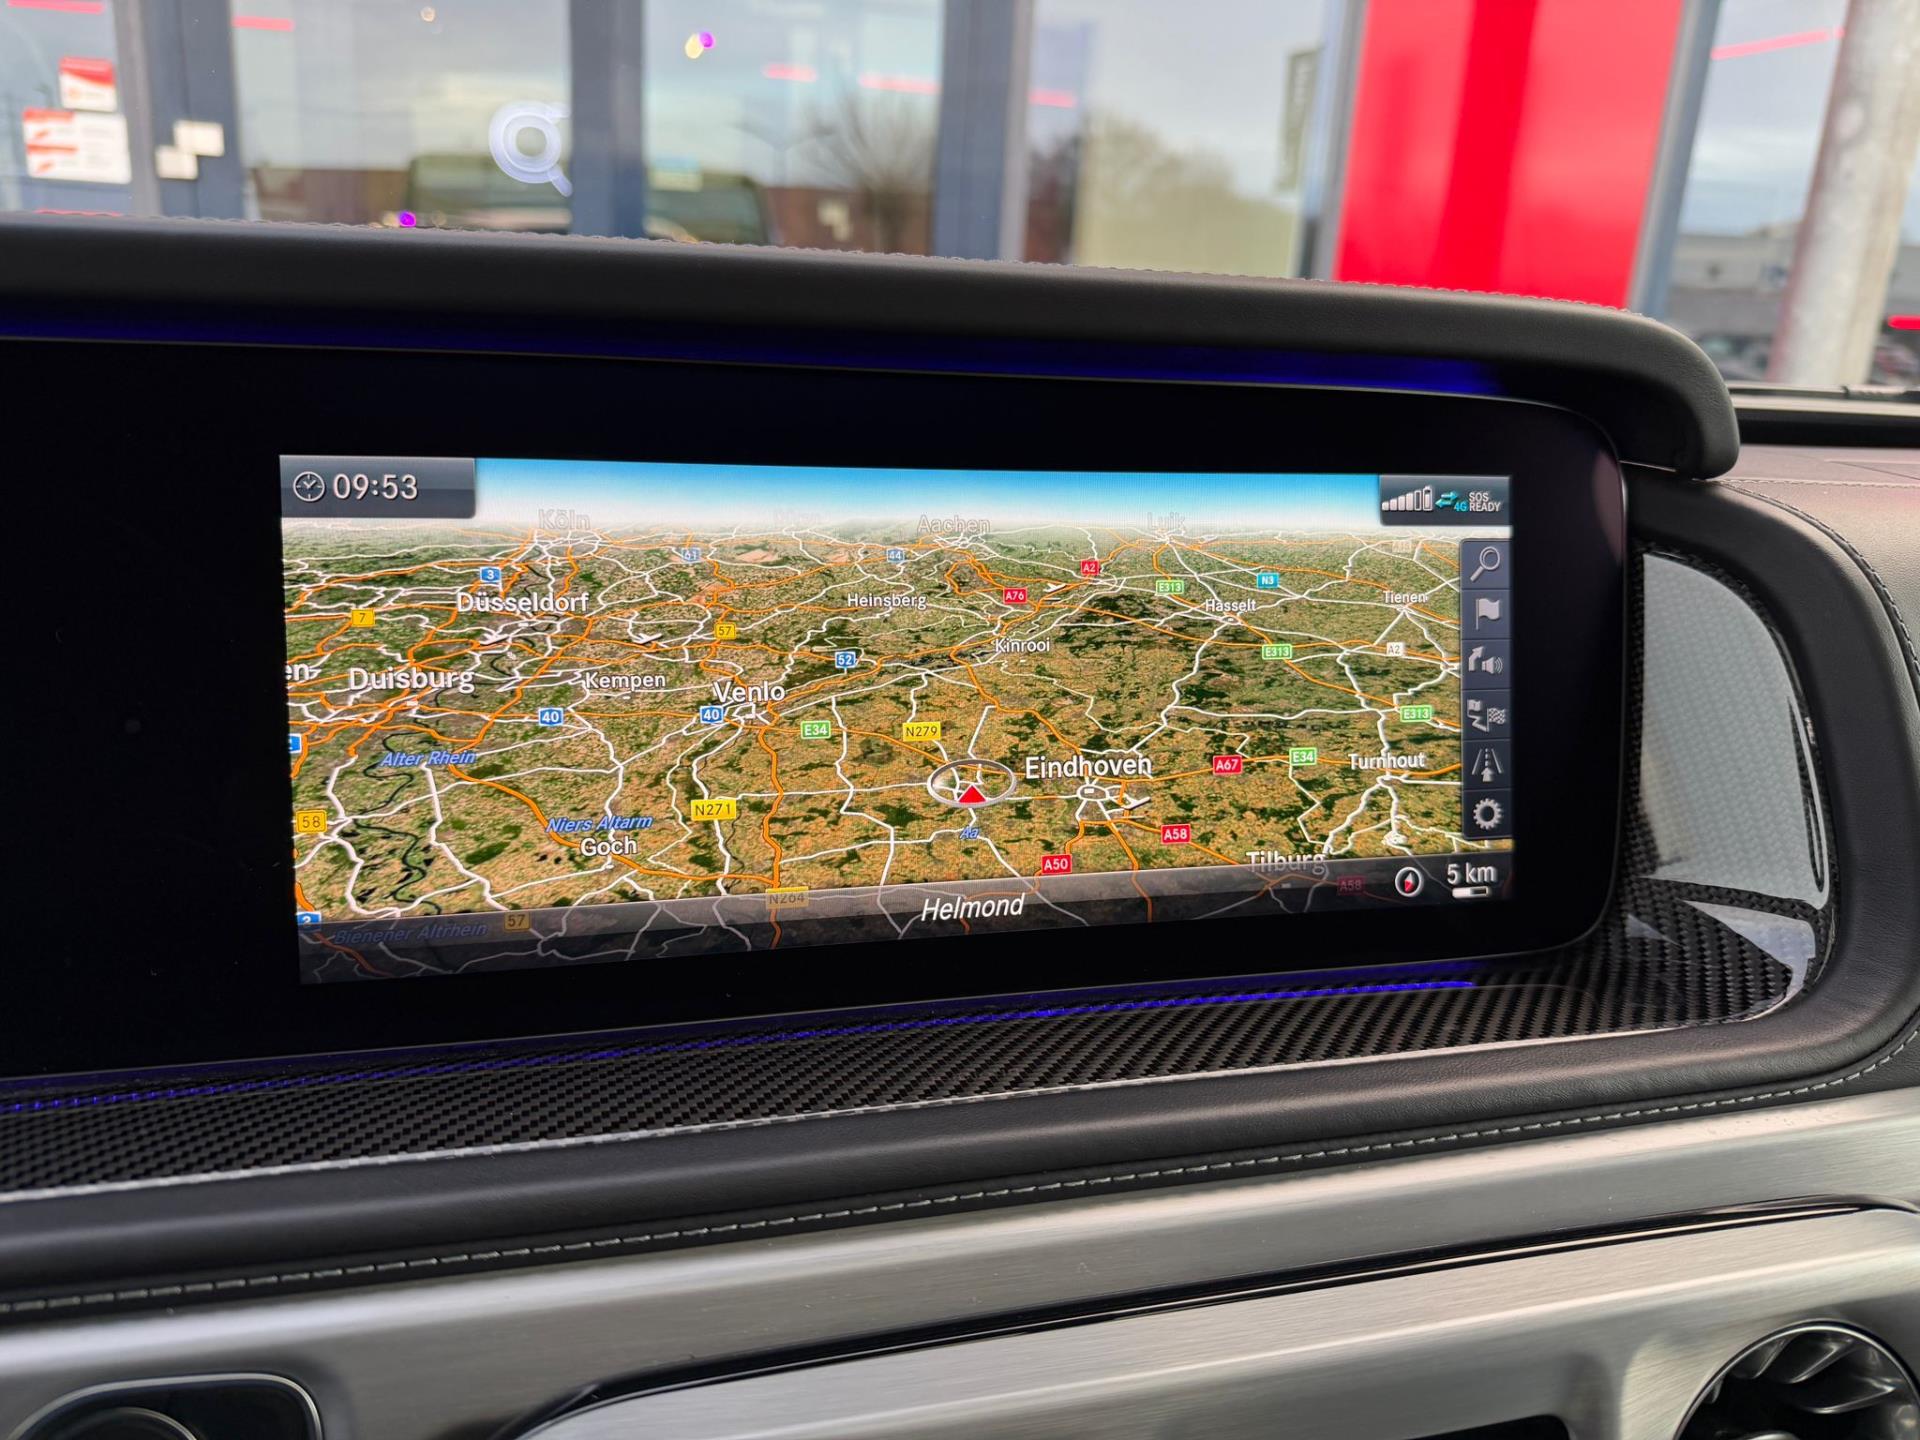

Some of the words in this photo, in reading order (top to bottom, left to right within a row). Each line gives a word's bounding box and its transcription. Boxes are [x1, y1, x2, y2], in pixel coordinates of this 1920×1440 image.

[333, 474, 418, 500] 09:53
[1469, 492, 1489, 502] SOS
[1454, 501, 1468, 512] 4G
[1469, 501, 1501, 512] READY
[538, 509, 591, 530] Köln
[917, 515, 990, 533] Aachen
[1083, 563, 1096, 573] A2
[1158, 582, 1182, 592] E313
[456, 591, 589, 613] Düsseldorf
[847, 593, 927, 610] Heinsberg
[1005, 590, 1025, 601] A76
[1383, 591, 1427, 604] Tienen
[1205, 598, 1257, 612] Hasselt
[995, 637, 1051, 653] Kinrooi
[1265, 646, 1290, 657] E313
[1388, 644, 1401, 654] A2
[837, 655, 853, 666] 52
[350, 666, 475, 693] Duisburg
[585, 672, 666, 690] Kempen
[712, 681, 786, 703] Venlo
[542, 712, 560, 723] 40
[703, 709, 720, 720] 40
[1403, 708, 1429, 719] E313
[804, 724, 828, 736] E34
[906, 725, 938, 738] N279
[380, 752, 422, 767] Alter
[426, 750, 477, 765] Rhein
[1292, 750, 1314, 762] E34
[1348, 753, 1426, 770] Turnhout
[1025, 756, 1152, 779] Eindhoven
[1215, 758, 1239, 771] A67
[694, 804, 732, 817] N271
[302, 816, 321, 828] 58
[545, 817, 592, 832] Niers
[596, 815, 654, 830] Altarm
[960, 827, 980, 840] Aa
[1163, 828, 1188, 841] A58
[580, 836, 638, 857] Goch
[1043, 858, 1069, 871] A50
[1246, 850, 1327, 875] Tilburg
[1447, 864, 1459, 885] 5
[1465, 862, 1496, 884] km
[1339, 880, 1362, 892] A58
[921, 892, 1026, 922] Helmond
[508, 914, 526, 927] 57
[334, 927, 413, 945] Bienener
[417, 922, 488, 940] Altrhein
